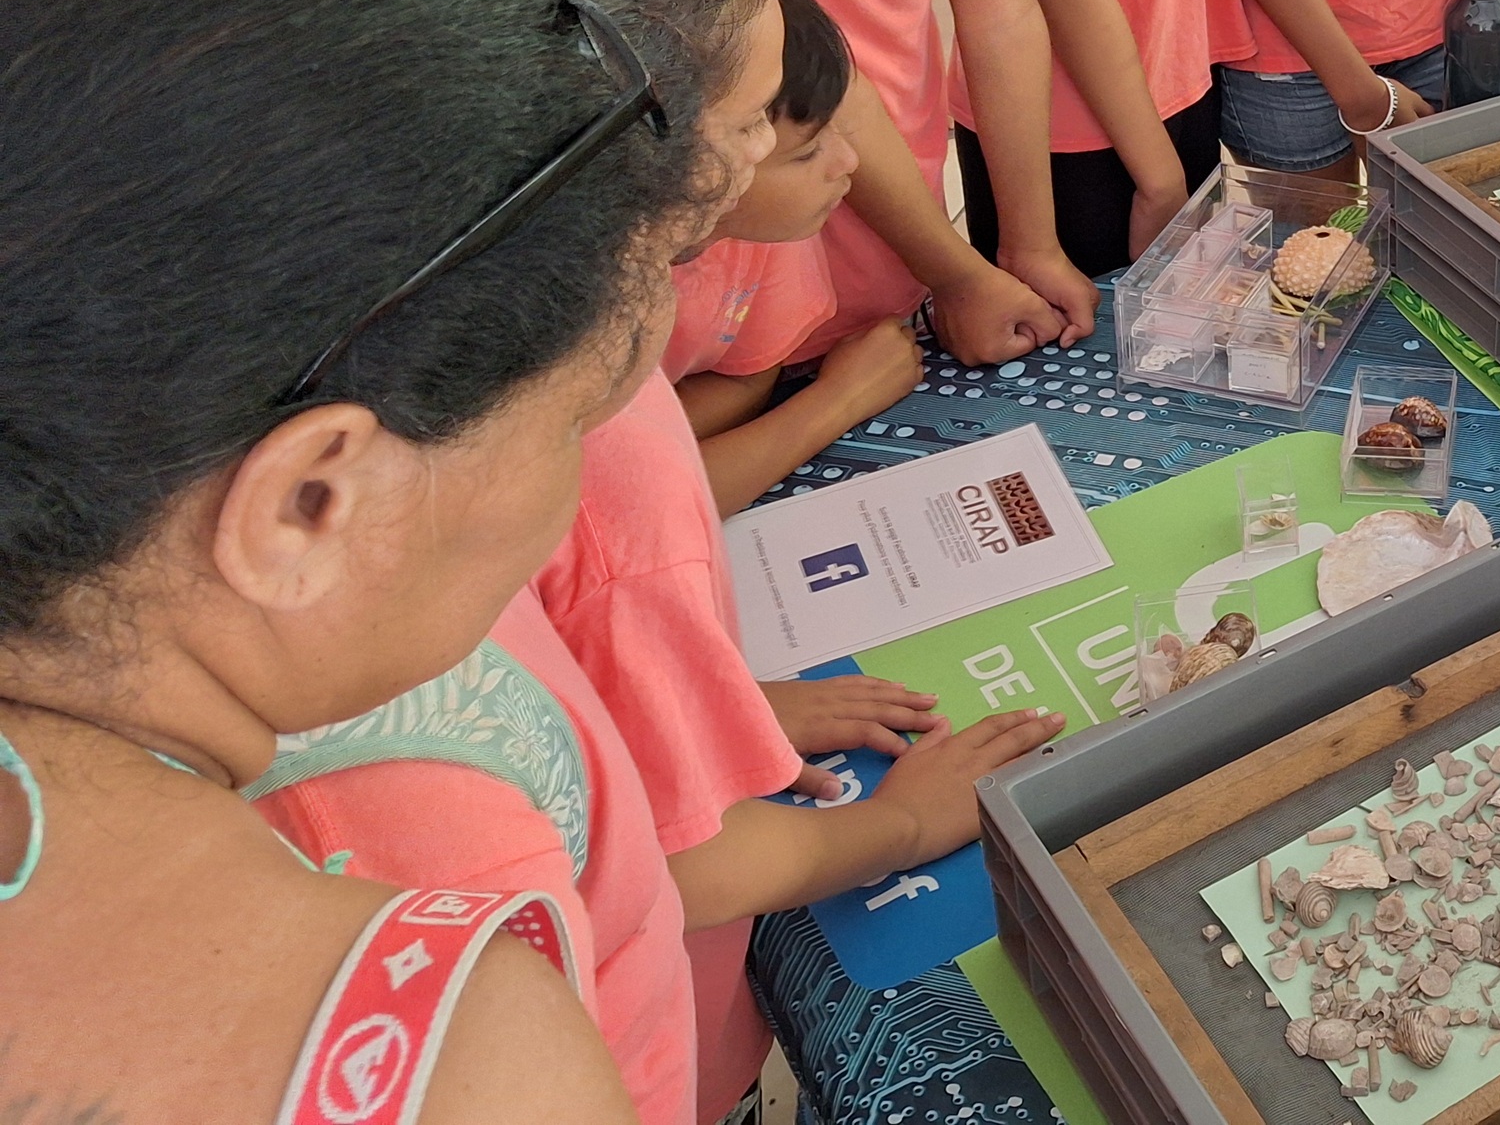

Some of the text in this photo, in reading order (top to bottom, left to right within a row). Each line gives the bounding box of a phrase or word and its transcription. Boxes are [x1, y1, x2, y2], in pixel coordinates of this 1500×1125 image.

[956, 484, 1009, 555] CIRAP
[904, 571, 921, 589] CIRAP
[962, 644, 1035, 709] DE
